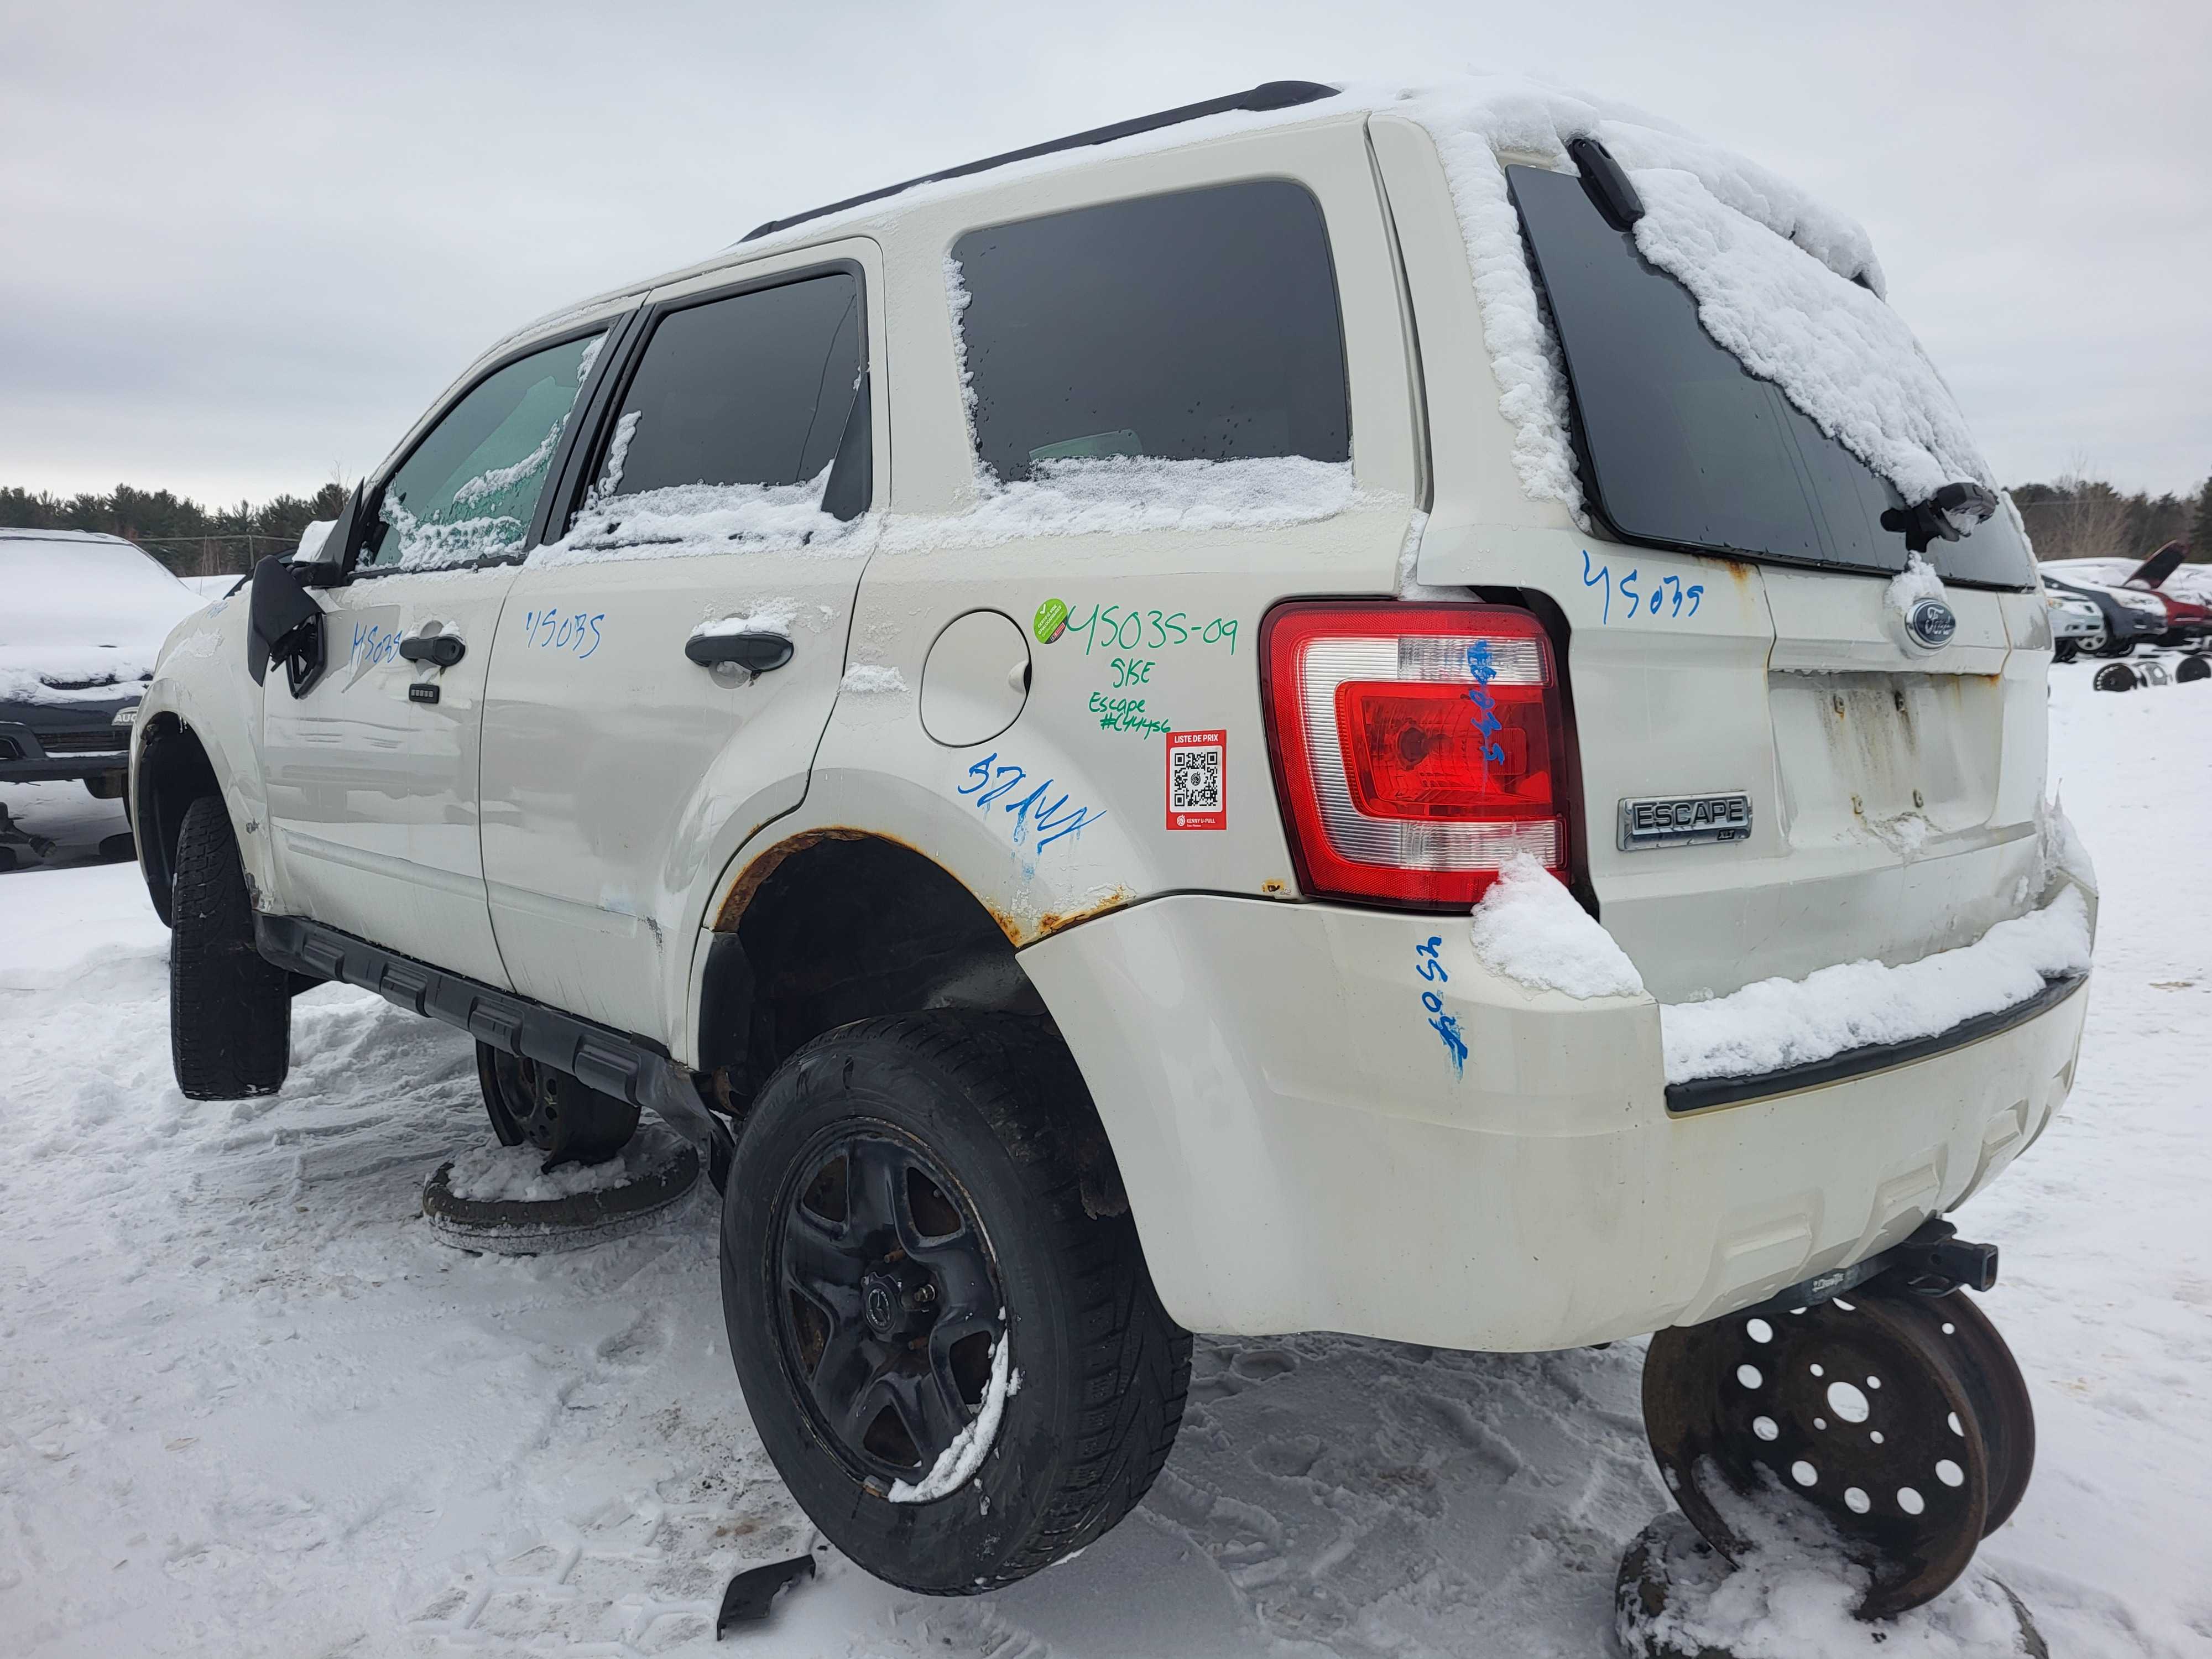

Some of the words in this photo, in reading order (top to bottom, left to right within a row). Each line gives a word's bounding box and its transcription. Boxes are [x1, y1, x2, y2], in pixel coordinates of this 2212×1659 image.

[1924, 606, 1951, 635] Ford
[1089, 691, 1145, 716] Escape
[1174, 734, 1192, 743] LISTE
[1193, 734, 1202, 743] DE
[1203, 733, 1219, 742] PRIX
[1635, 798, 1744, 830] ESCAPE
[1718, 830, 1735, 839] XLT
